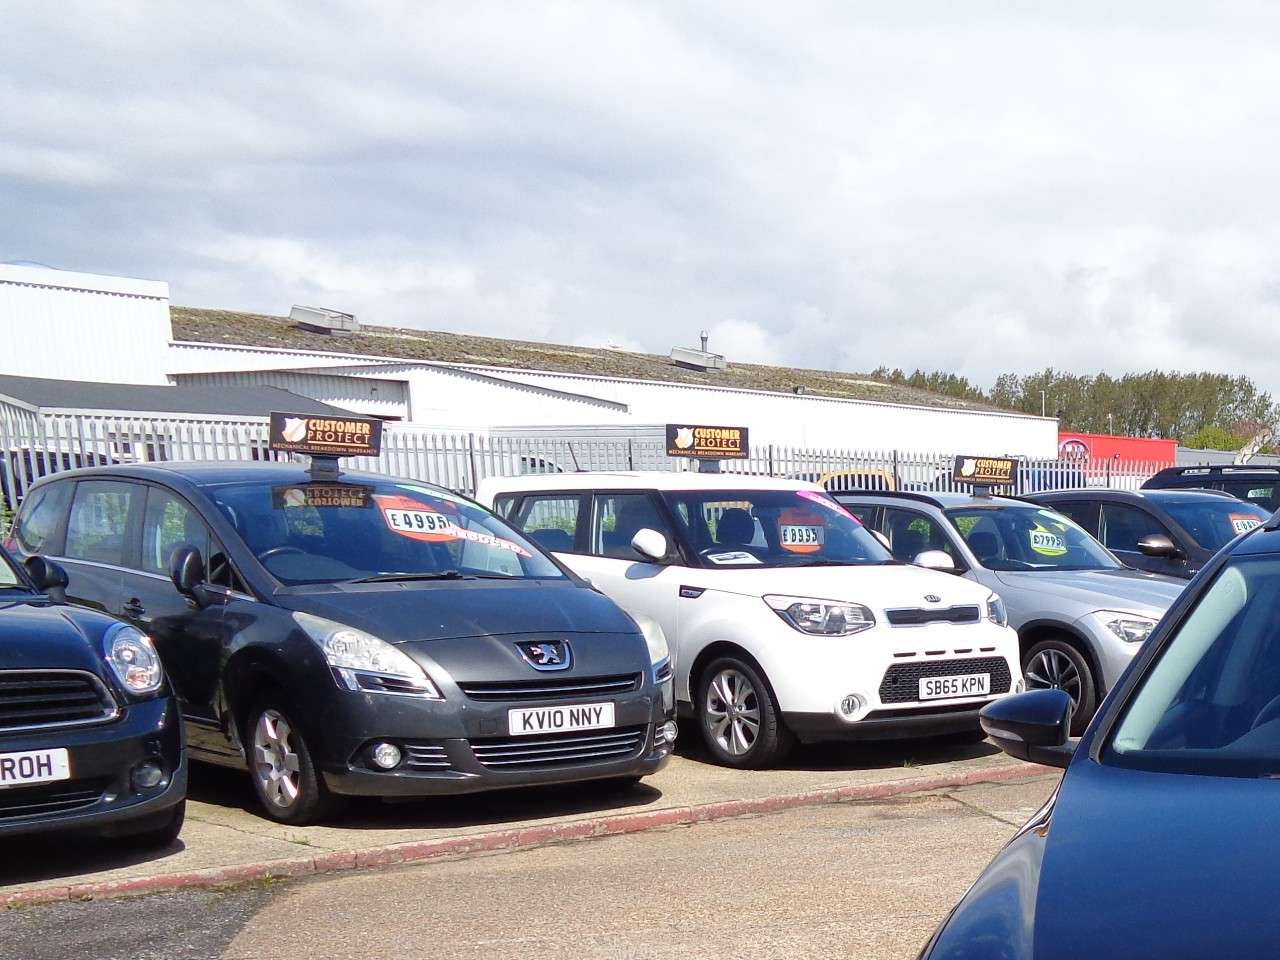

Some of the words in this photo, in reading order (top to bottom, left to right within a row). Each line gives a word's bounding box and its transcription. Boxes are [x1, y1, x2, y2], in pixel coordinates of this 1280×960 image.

[308, 419, 371, 434] CUSTOMER
[694, 427, 741, 440] CUSTOMER
[307, 431, 371, 444] PROTECT
[694, 438, 741, 448] PROTECT
[976, 459, 1012, 469] CUSTOMER
[975, 467, 1011, 476] PROTECT
[391, 513, 448, 530] £4995
[783, 528, 817, 542] £8995
[926, 678, 958, 696] SB65
[961, 676, 985, 693] KPN
[522, 710, 564, 731] KV10
[569, 706, 603, 727] NNY
[0, 754, 53, 781] ROH
